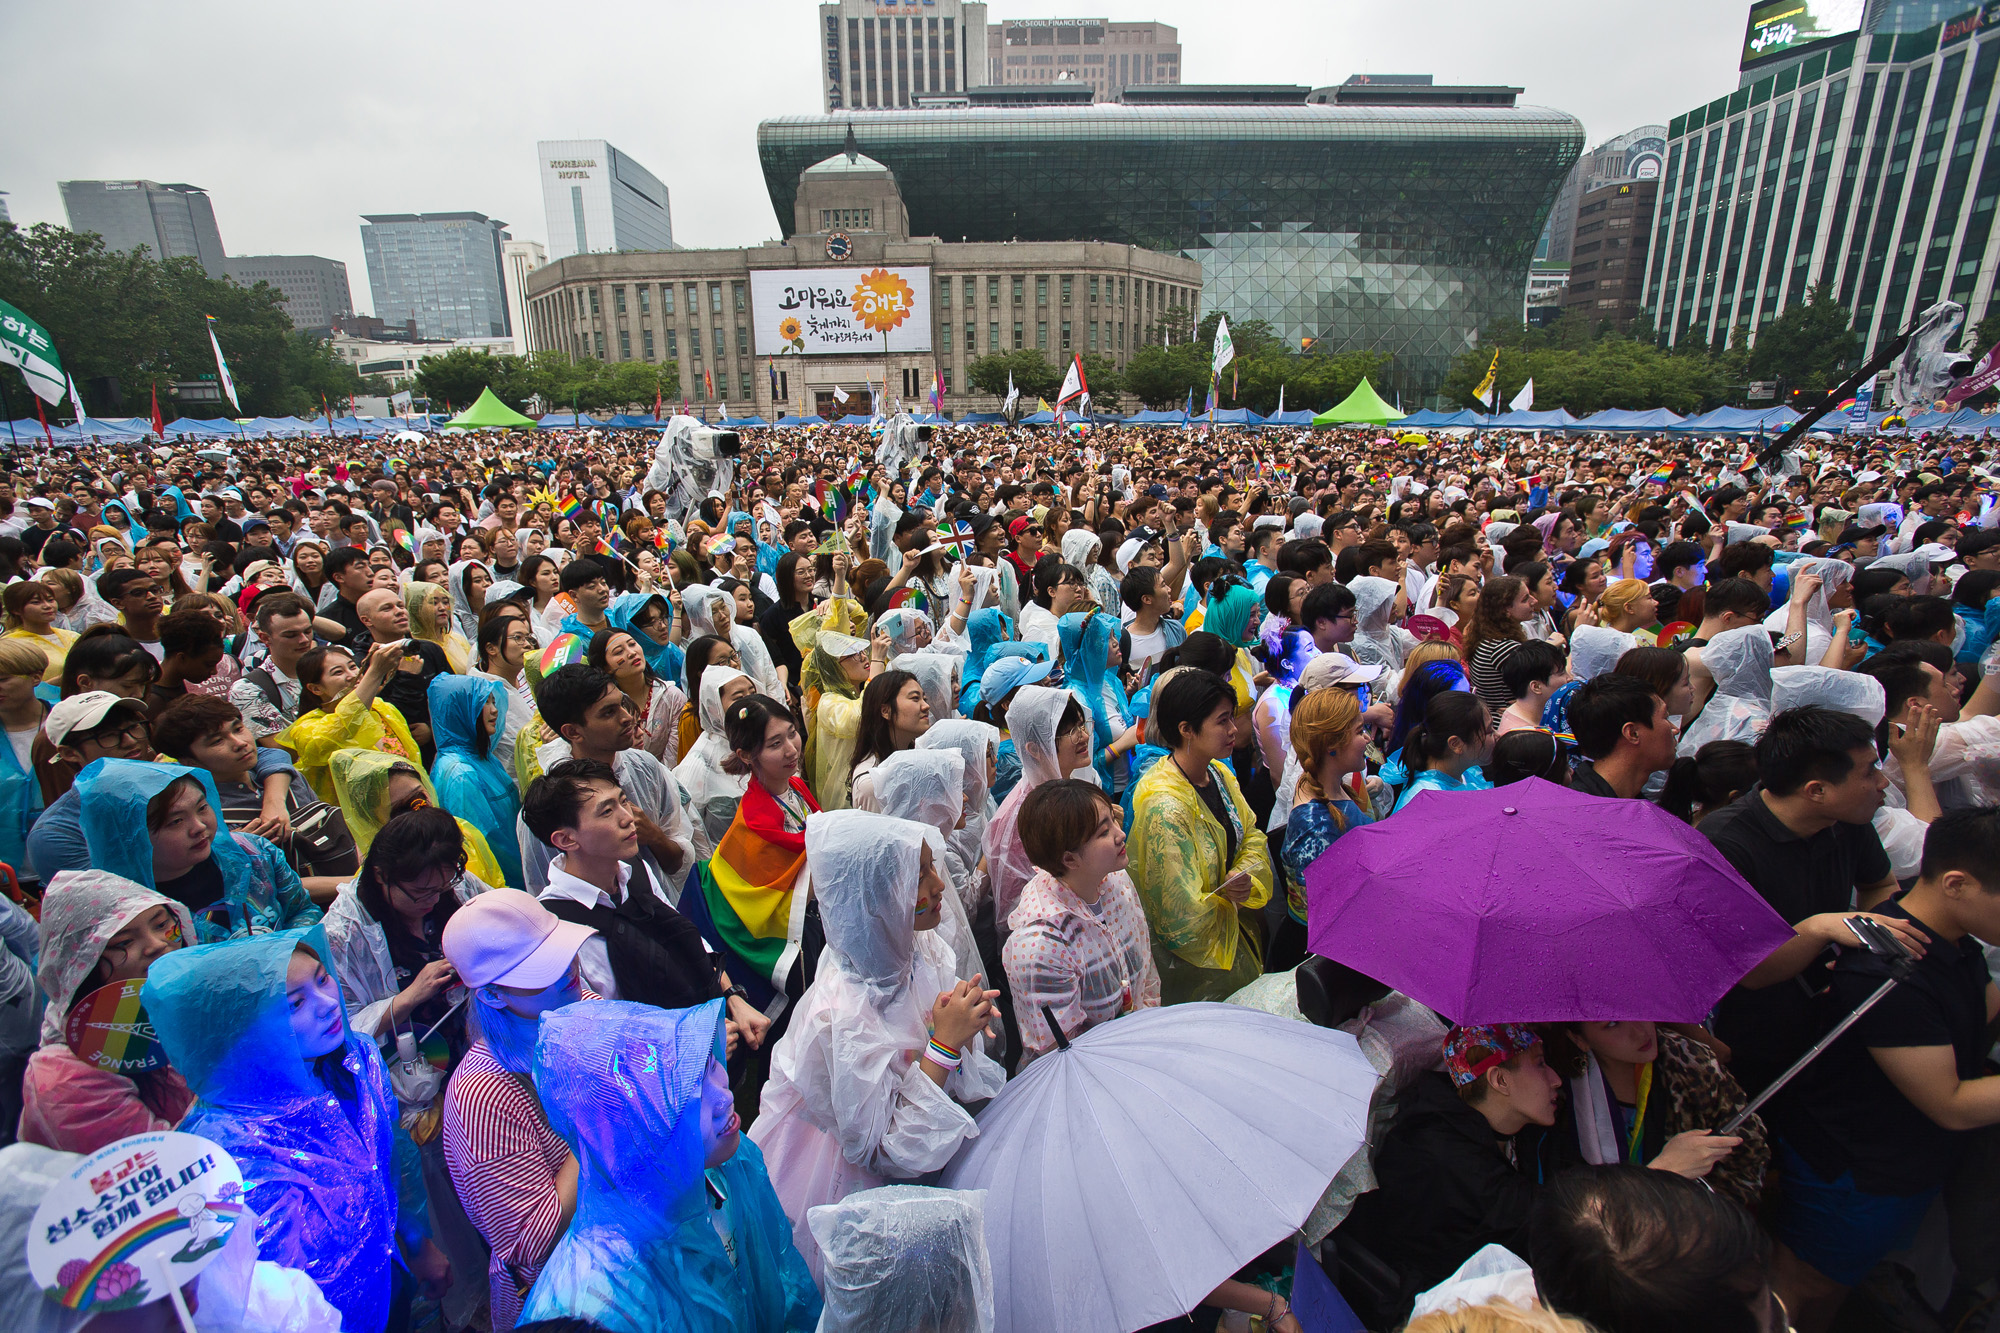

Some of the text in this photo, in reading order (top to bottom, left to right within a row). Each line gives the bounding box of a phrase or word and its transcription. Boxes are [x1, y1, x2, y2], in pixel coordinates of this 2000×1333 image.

[1025, 19, 1046, 27] SEOUL
[1048, 19, 1075, 27] FINANCE
[1076, 19, 1101, 27] CENTER
[550, 159, 597, 168] KOREANA
[558, 170, 591, 179] HOTEL
[778, 285, 906, 314] 고마워요 해님
[806, 314, 850, 336] 늦게까지
[823, 490, 837, 509] 뭐
[552, 645, 571, 668] 뭐
[206, 684, 228, 694] AND
[88, 1050, 159, 1070] FRANCE
[90, 1150, 158, 1196] 불교는
[45, 1164, 163, 1245] 성소수자와
[91, 1153, 217, 1241] 함께 합니다!
